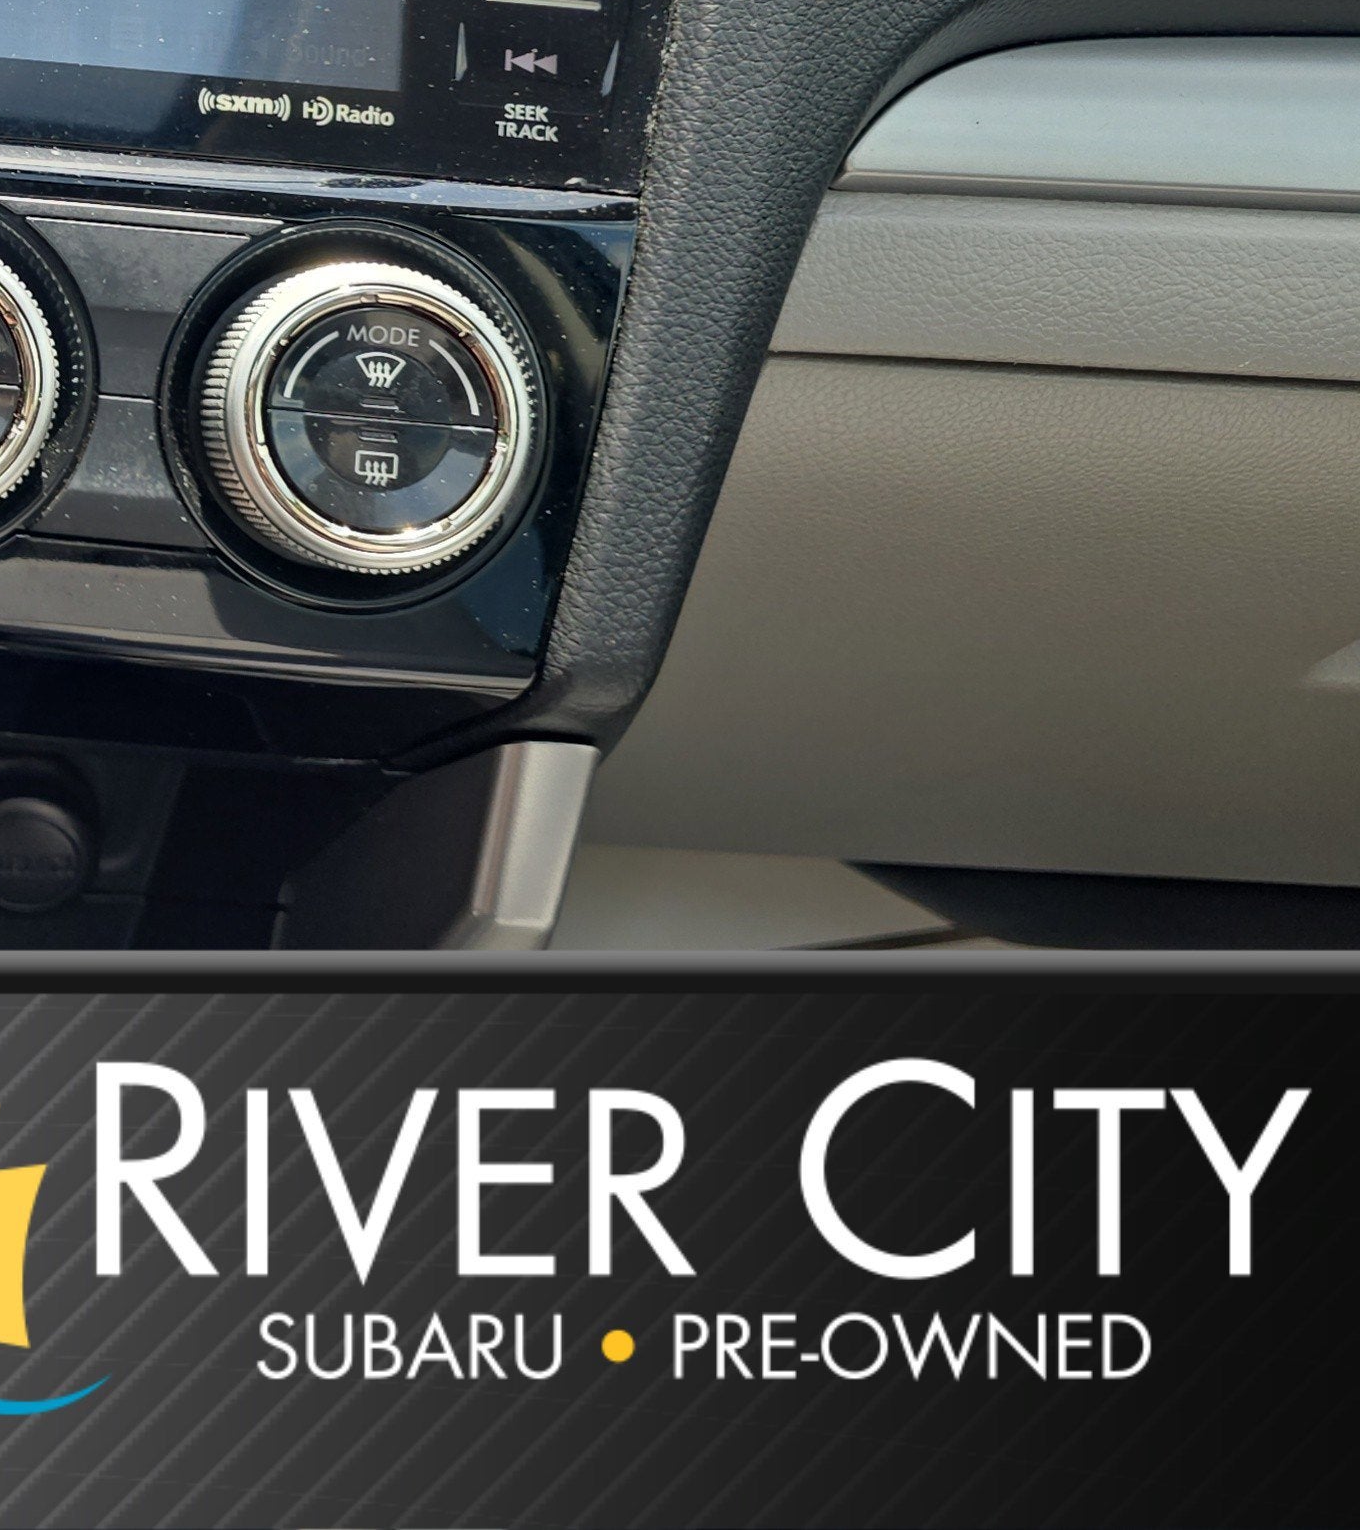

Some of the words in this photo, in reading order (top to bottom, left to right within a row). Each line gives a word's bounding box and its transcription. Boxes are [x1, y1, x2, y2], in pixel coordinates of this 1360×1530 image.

[336, 104, 395, 127] Radio
[504, 103, 549, 122] SEEK
[495, 121, 559, 142] TRACK
[346, 325, 419, 347] MODE
